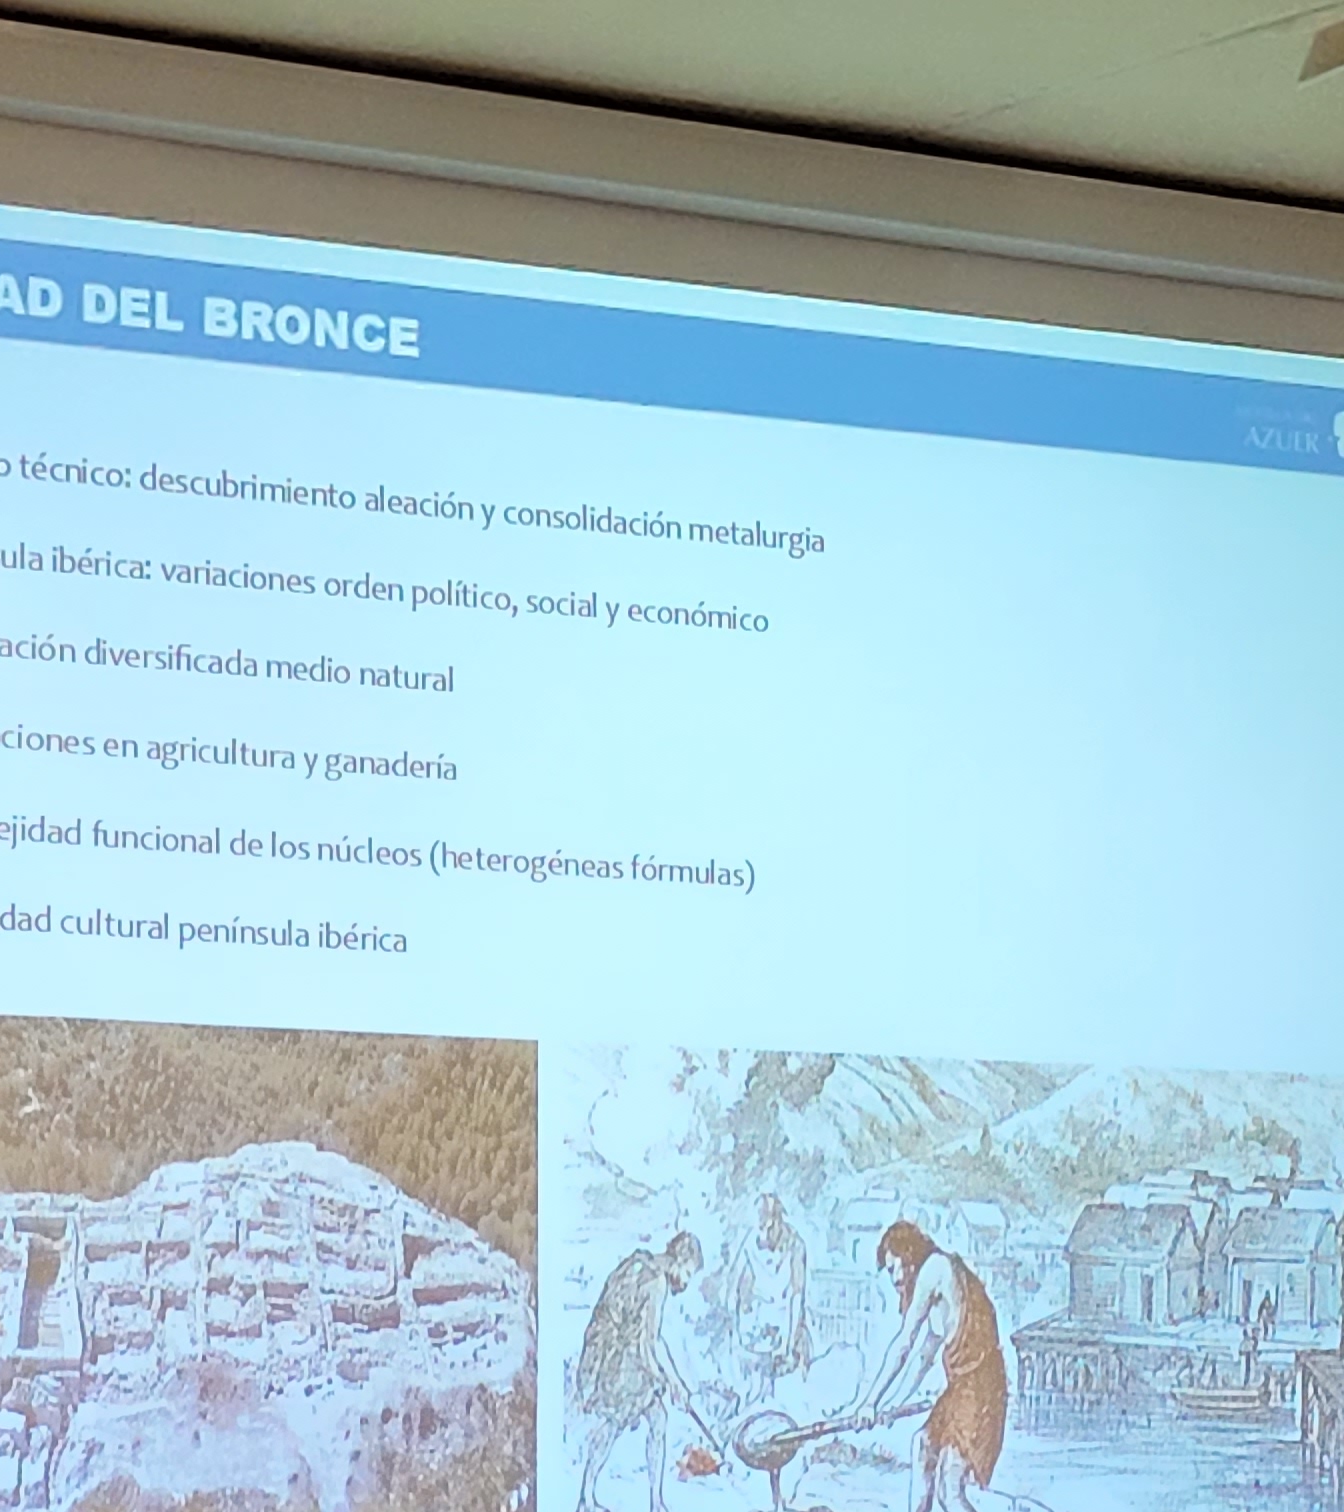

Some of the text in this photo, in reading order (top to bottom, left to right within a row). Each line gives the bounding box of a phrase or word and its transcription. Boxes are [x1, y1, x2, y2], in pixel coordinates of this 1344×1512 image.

[82, 283, 184, 333] DEL
[202, 296, 421, 360] BRONCE
[19, 451, 132, 489] técnico:
[139, 464, 356, 510] descubrimiento
[364, 484, 475, 521] aleación
[480, 503, 496, 530] y
[503, 504, 682, 540] consolidación
[688, 520, 826, 559] metalurgia
[51, 545, 152, 580] ibérica:
[161, 560, 316, 595] variaciones
[323, 573, 404, 602] orden
[411, 579, 519, 617] político,
[526, 591, 598, 619] social
[605, 599, 619, 628] y
[627, 600, 769, 634] económico
[85, 638, 258, 677] diversificada
[265, 656, 351, 685] medio
[359, 665, 454, 694] natural
[103, 738, 139, 758] en
[147, 737, 296, 771] agricultura
[303, 751, 318, 780] y
[324, 750, 458, 783] ganadería
[92, 820, 220, 855] funcional
[229, 829, 263, 858] de
[270, 831, 311, 862] los
[317, 834, 422, 869] núcleos
[428, 838, 624, 884] (heterogéneas
[630, 854, 756, 896] fórmulas)
[59, 908, 169, 941] cultural
[178, 916, 310, 950] península
[317, 922, 408, 953] ibérica
